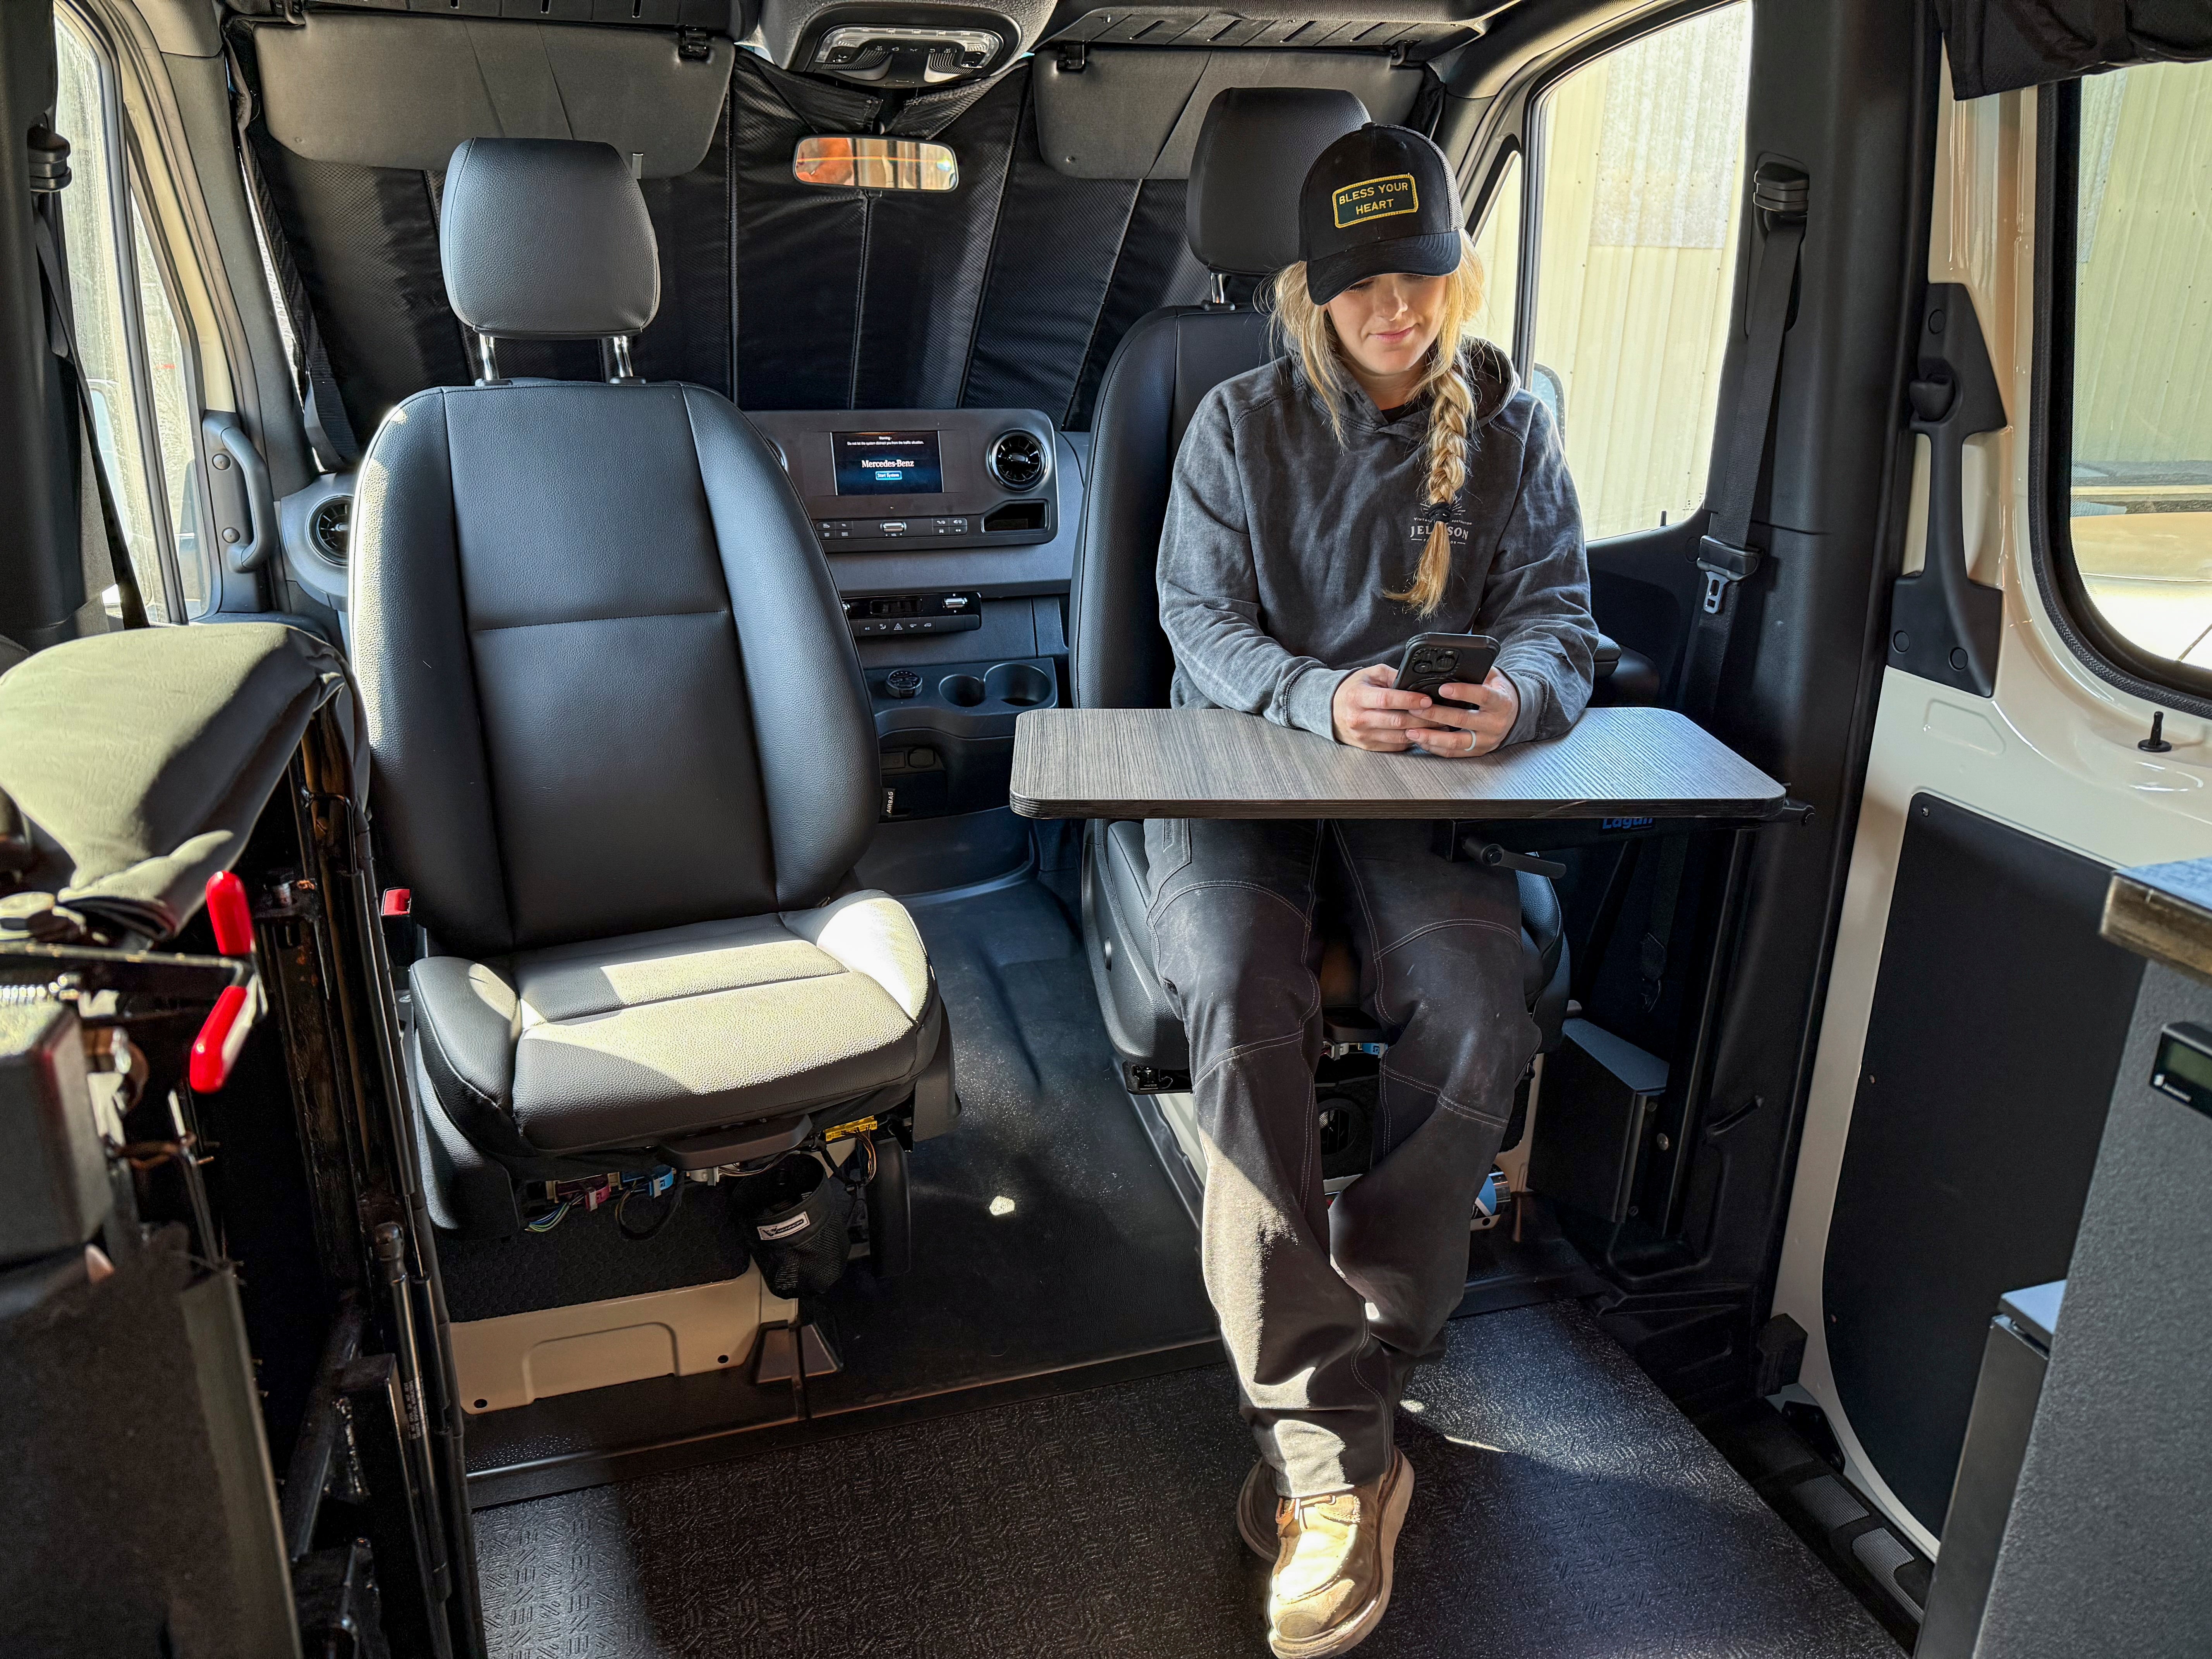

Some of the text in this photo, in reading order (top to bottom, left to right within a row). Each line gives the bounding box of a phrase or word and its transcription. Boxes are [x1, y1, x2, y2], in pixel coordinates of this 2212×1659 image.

[1339, 182, 1408, 205] BLESS YOUR
[1356, 199, 1394, 215] HEART
[862, 459, 914, 467] Mercedes-Benz
[1410, 526, 1468, 540] JELSON
